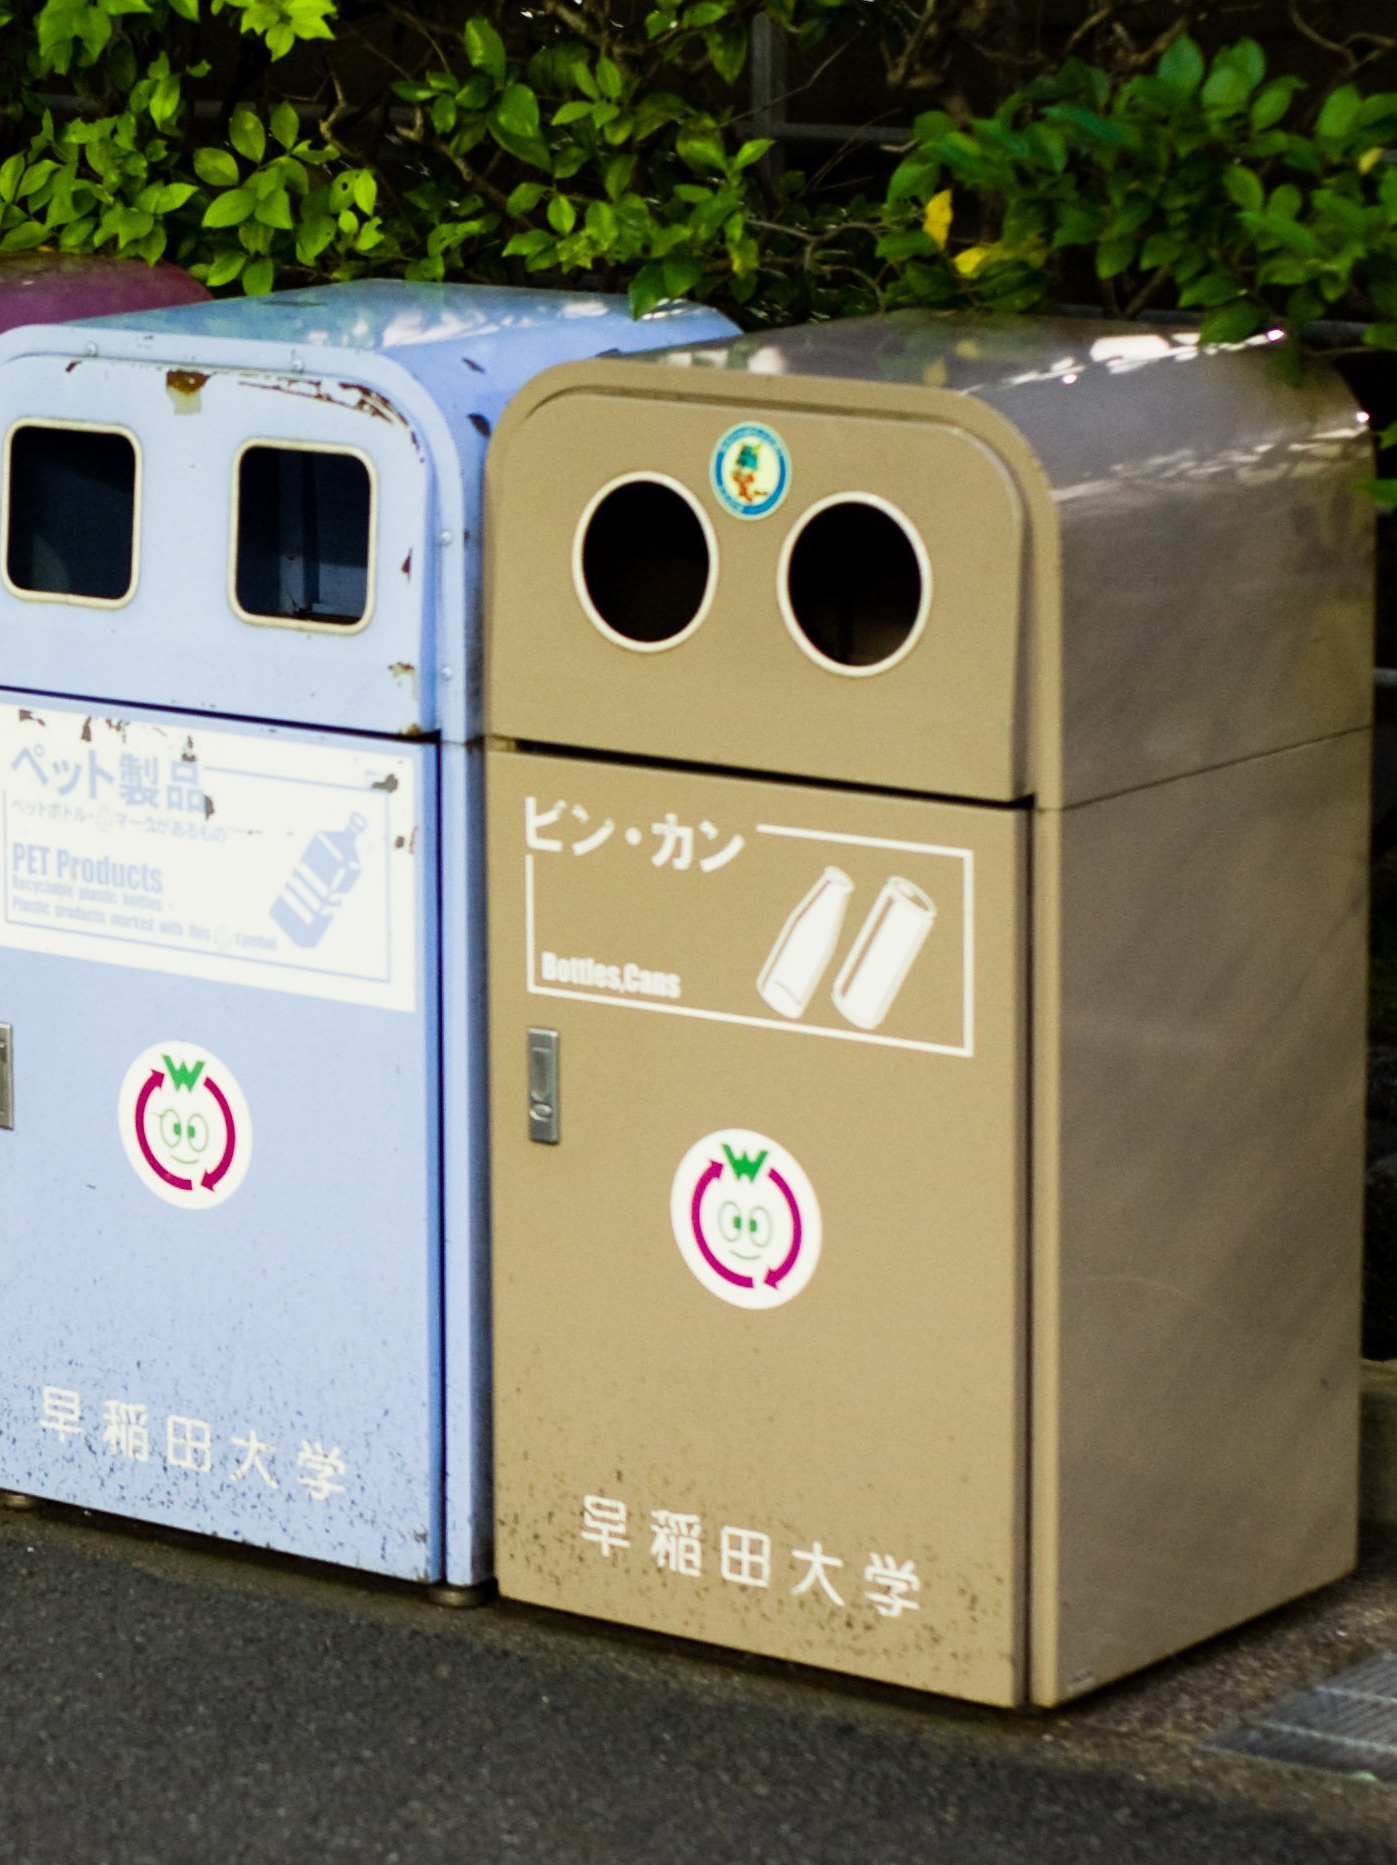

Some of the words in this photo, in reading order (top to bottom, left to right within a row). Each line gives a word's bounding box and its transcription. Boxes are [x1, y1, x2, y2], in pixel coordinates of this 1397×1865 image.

[10, 744, 206, 815] ペット製品
[12, 842, 51, 877] PET
[56, 848, 164, 894] Products
[525, 796, 746, 874] ビン・カン
[541, 951, 682, 999] Bottles,Cans
[40, 1386, 348, 1502] 早稲田大学
[580, 1494, 922, 1618] 早稲田大学
